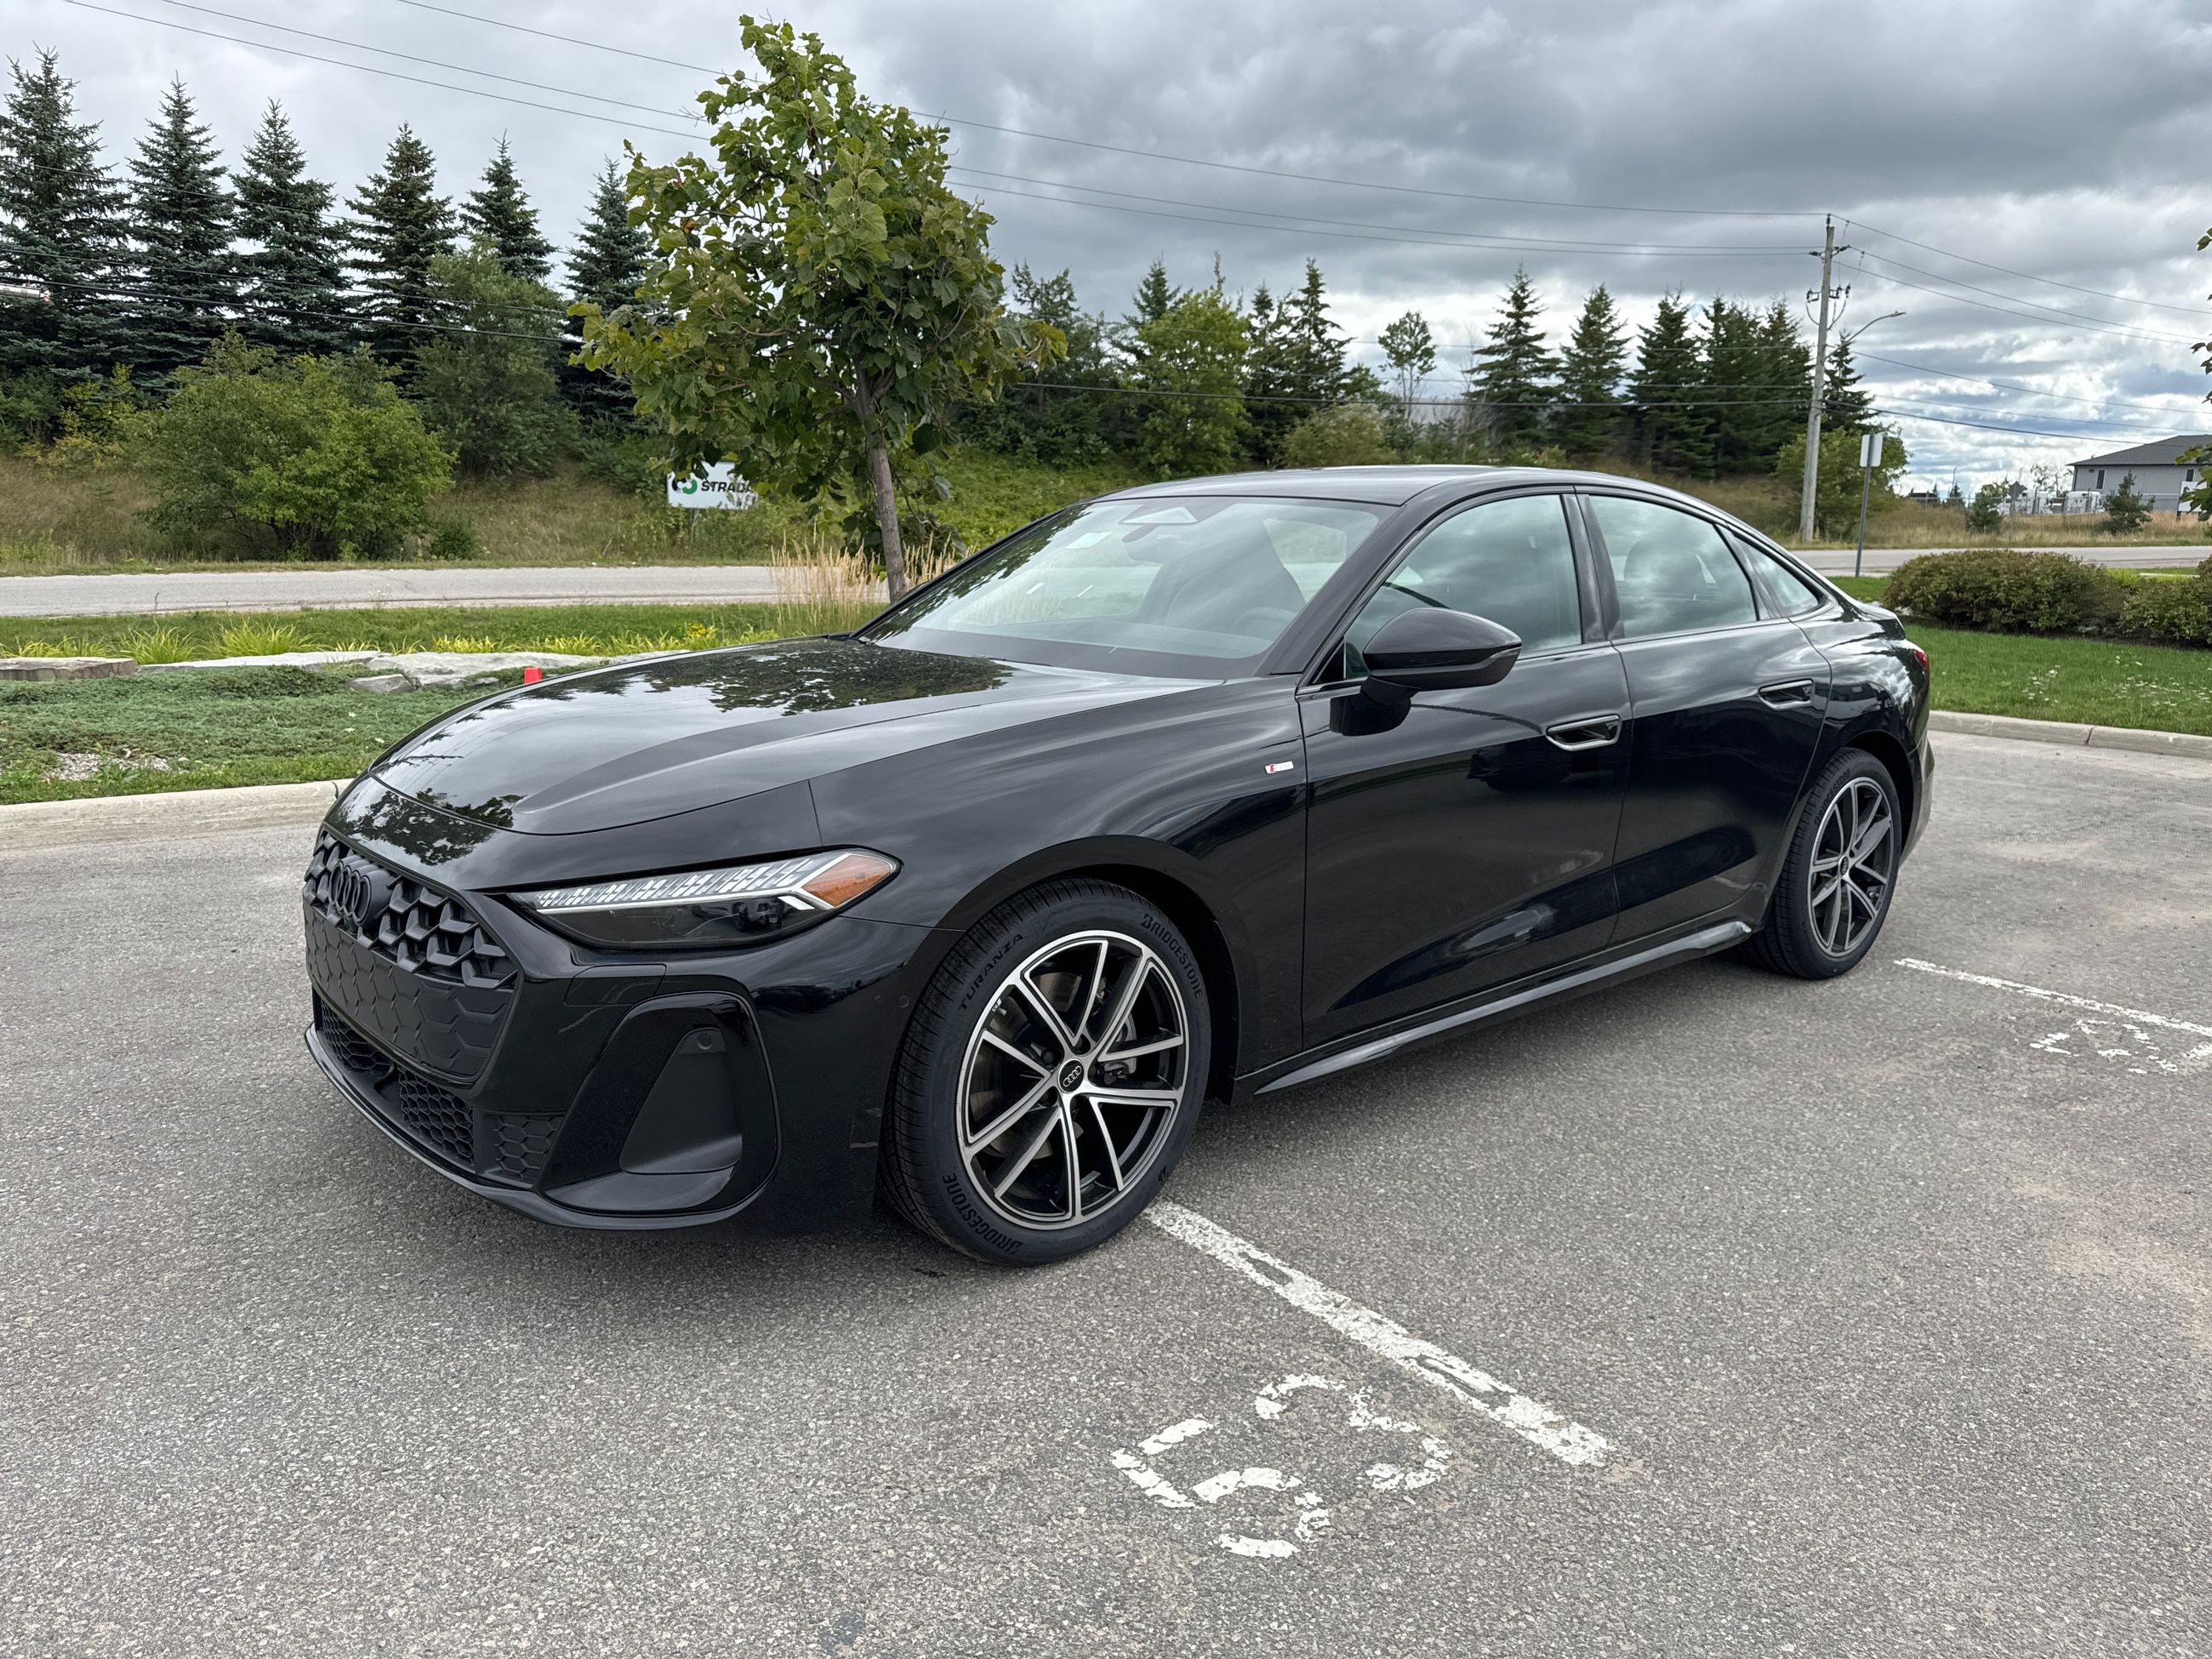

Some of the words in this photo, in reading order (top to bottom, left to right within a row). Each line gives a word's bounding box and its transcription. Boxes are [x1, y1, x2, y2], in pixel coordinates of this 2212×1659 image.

[958, 933, 1023, 1010] TURANZA
[1140, 913, 1203, 1000] BRIDGESTONE
[942, 1172, 1023, 1255] BRIDGESTONE
[1110, 1372, 1451, 1559] 53
